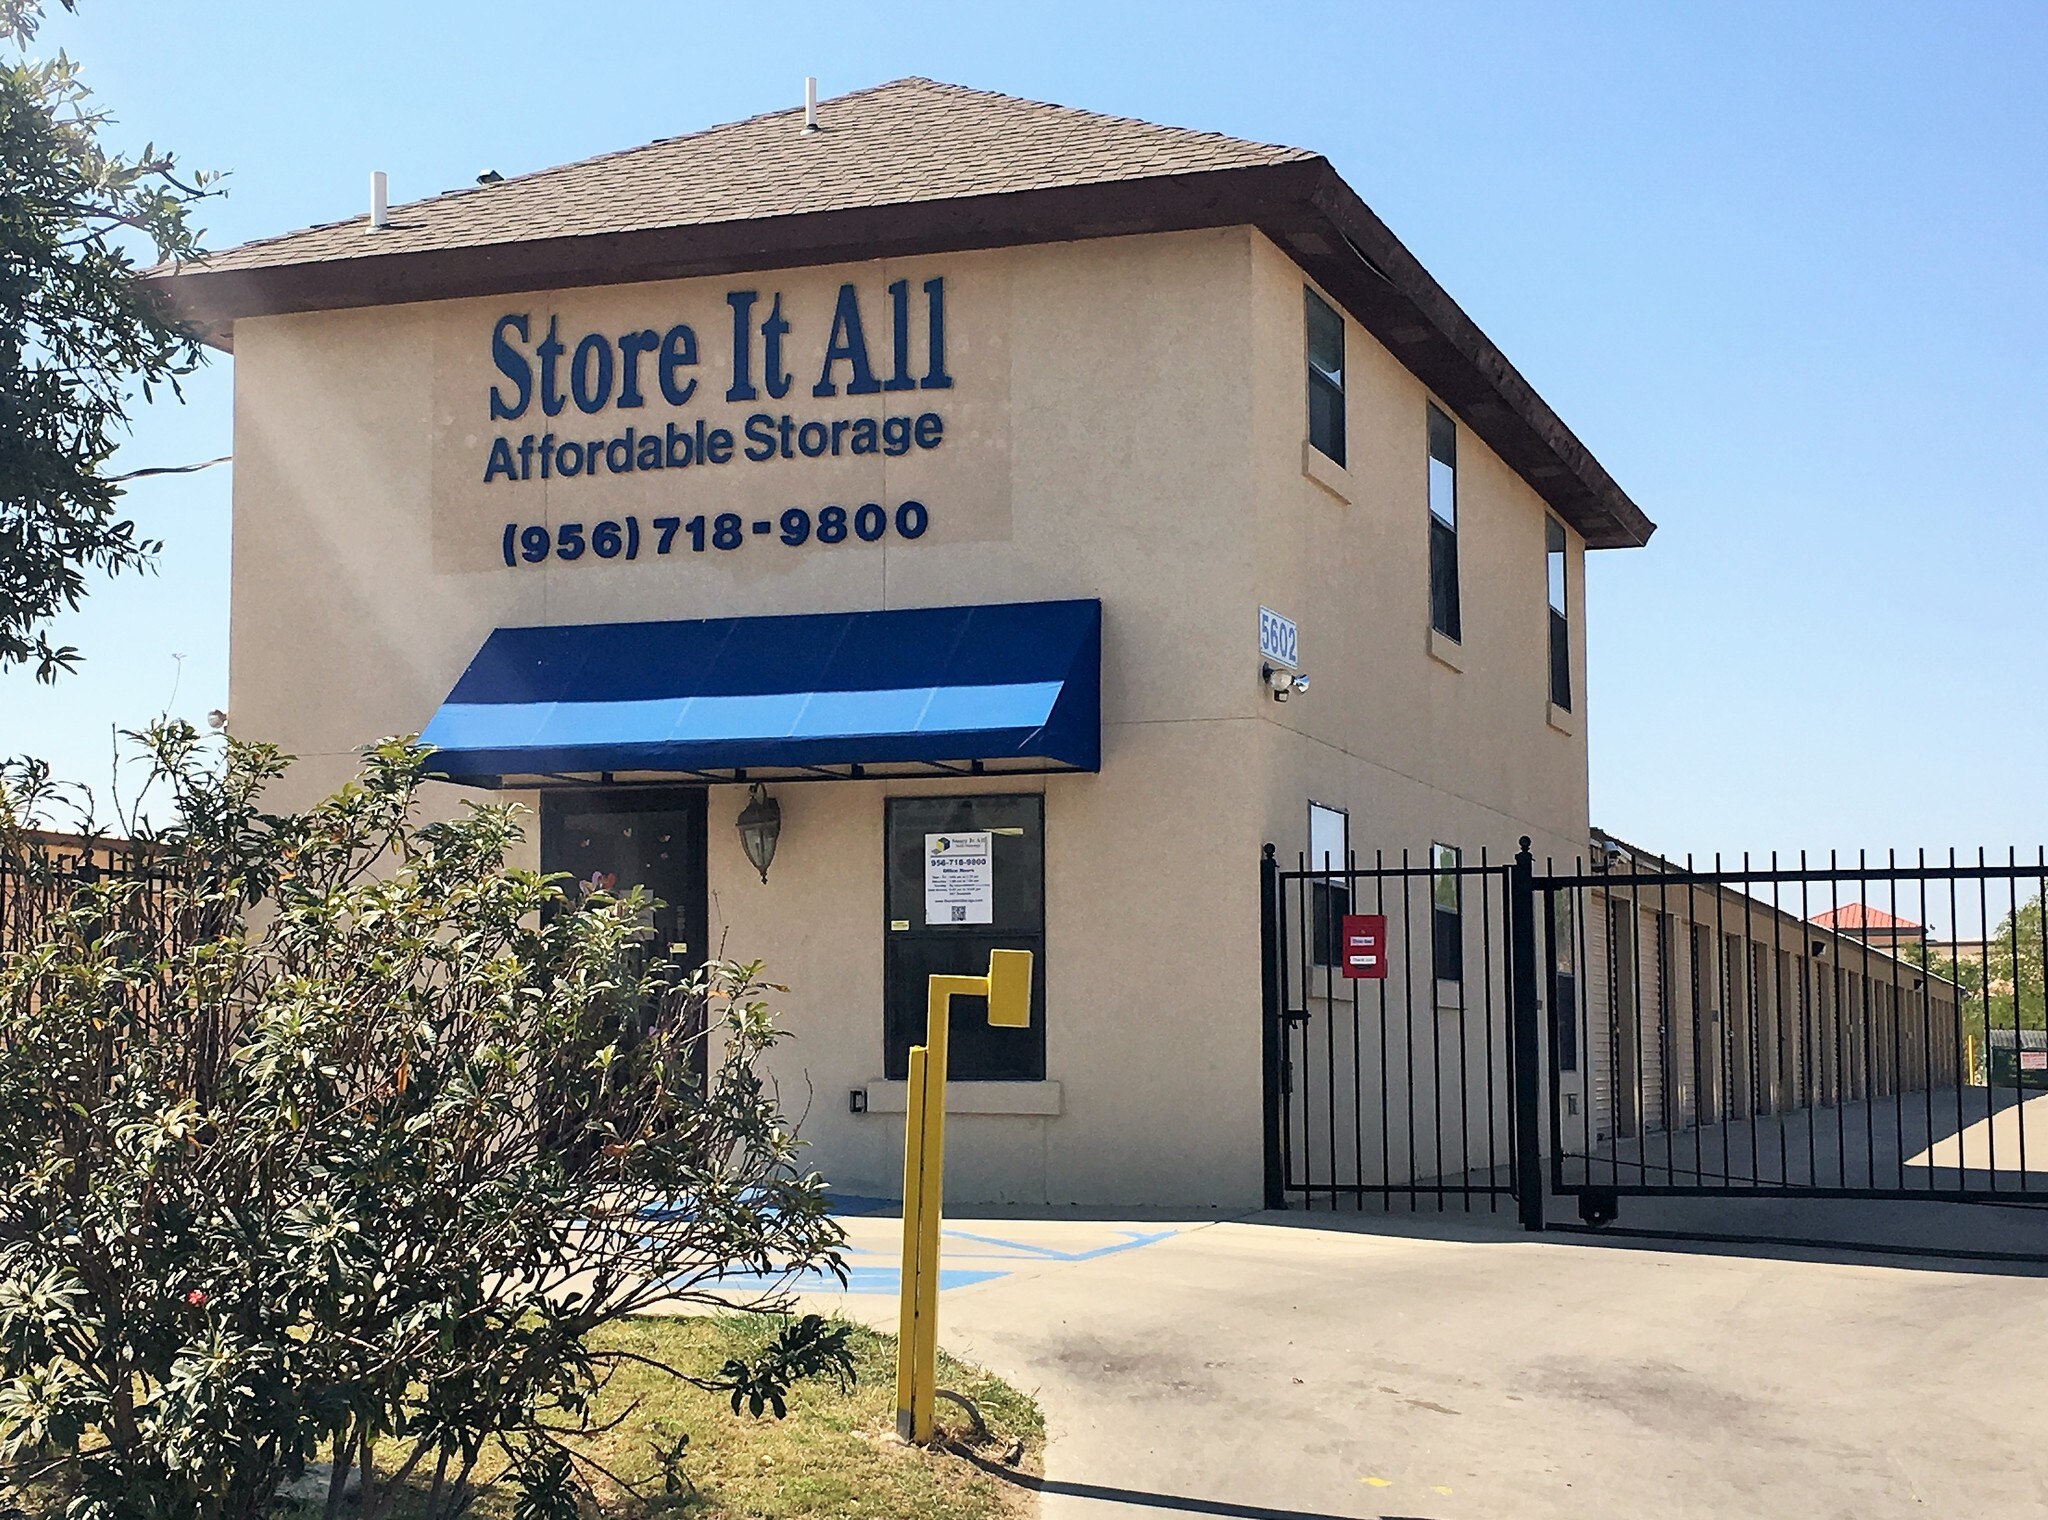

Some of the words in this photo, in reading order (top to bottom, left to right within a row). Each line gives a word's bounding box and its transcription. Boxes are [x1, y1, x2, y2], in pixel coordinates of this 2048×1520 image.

[490, 313, 698, 420] Store
[726, 290, 793, 402] It
[812, 276, 953, 398] All
[484, 419, 734, 483] Affordable
[744, 411, 945, 462] Storage
[1262, 614, 1296, 662] 5602
